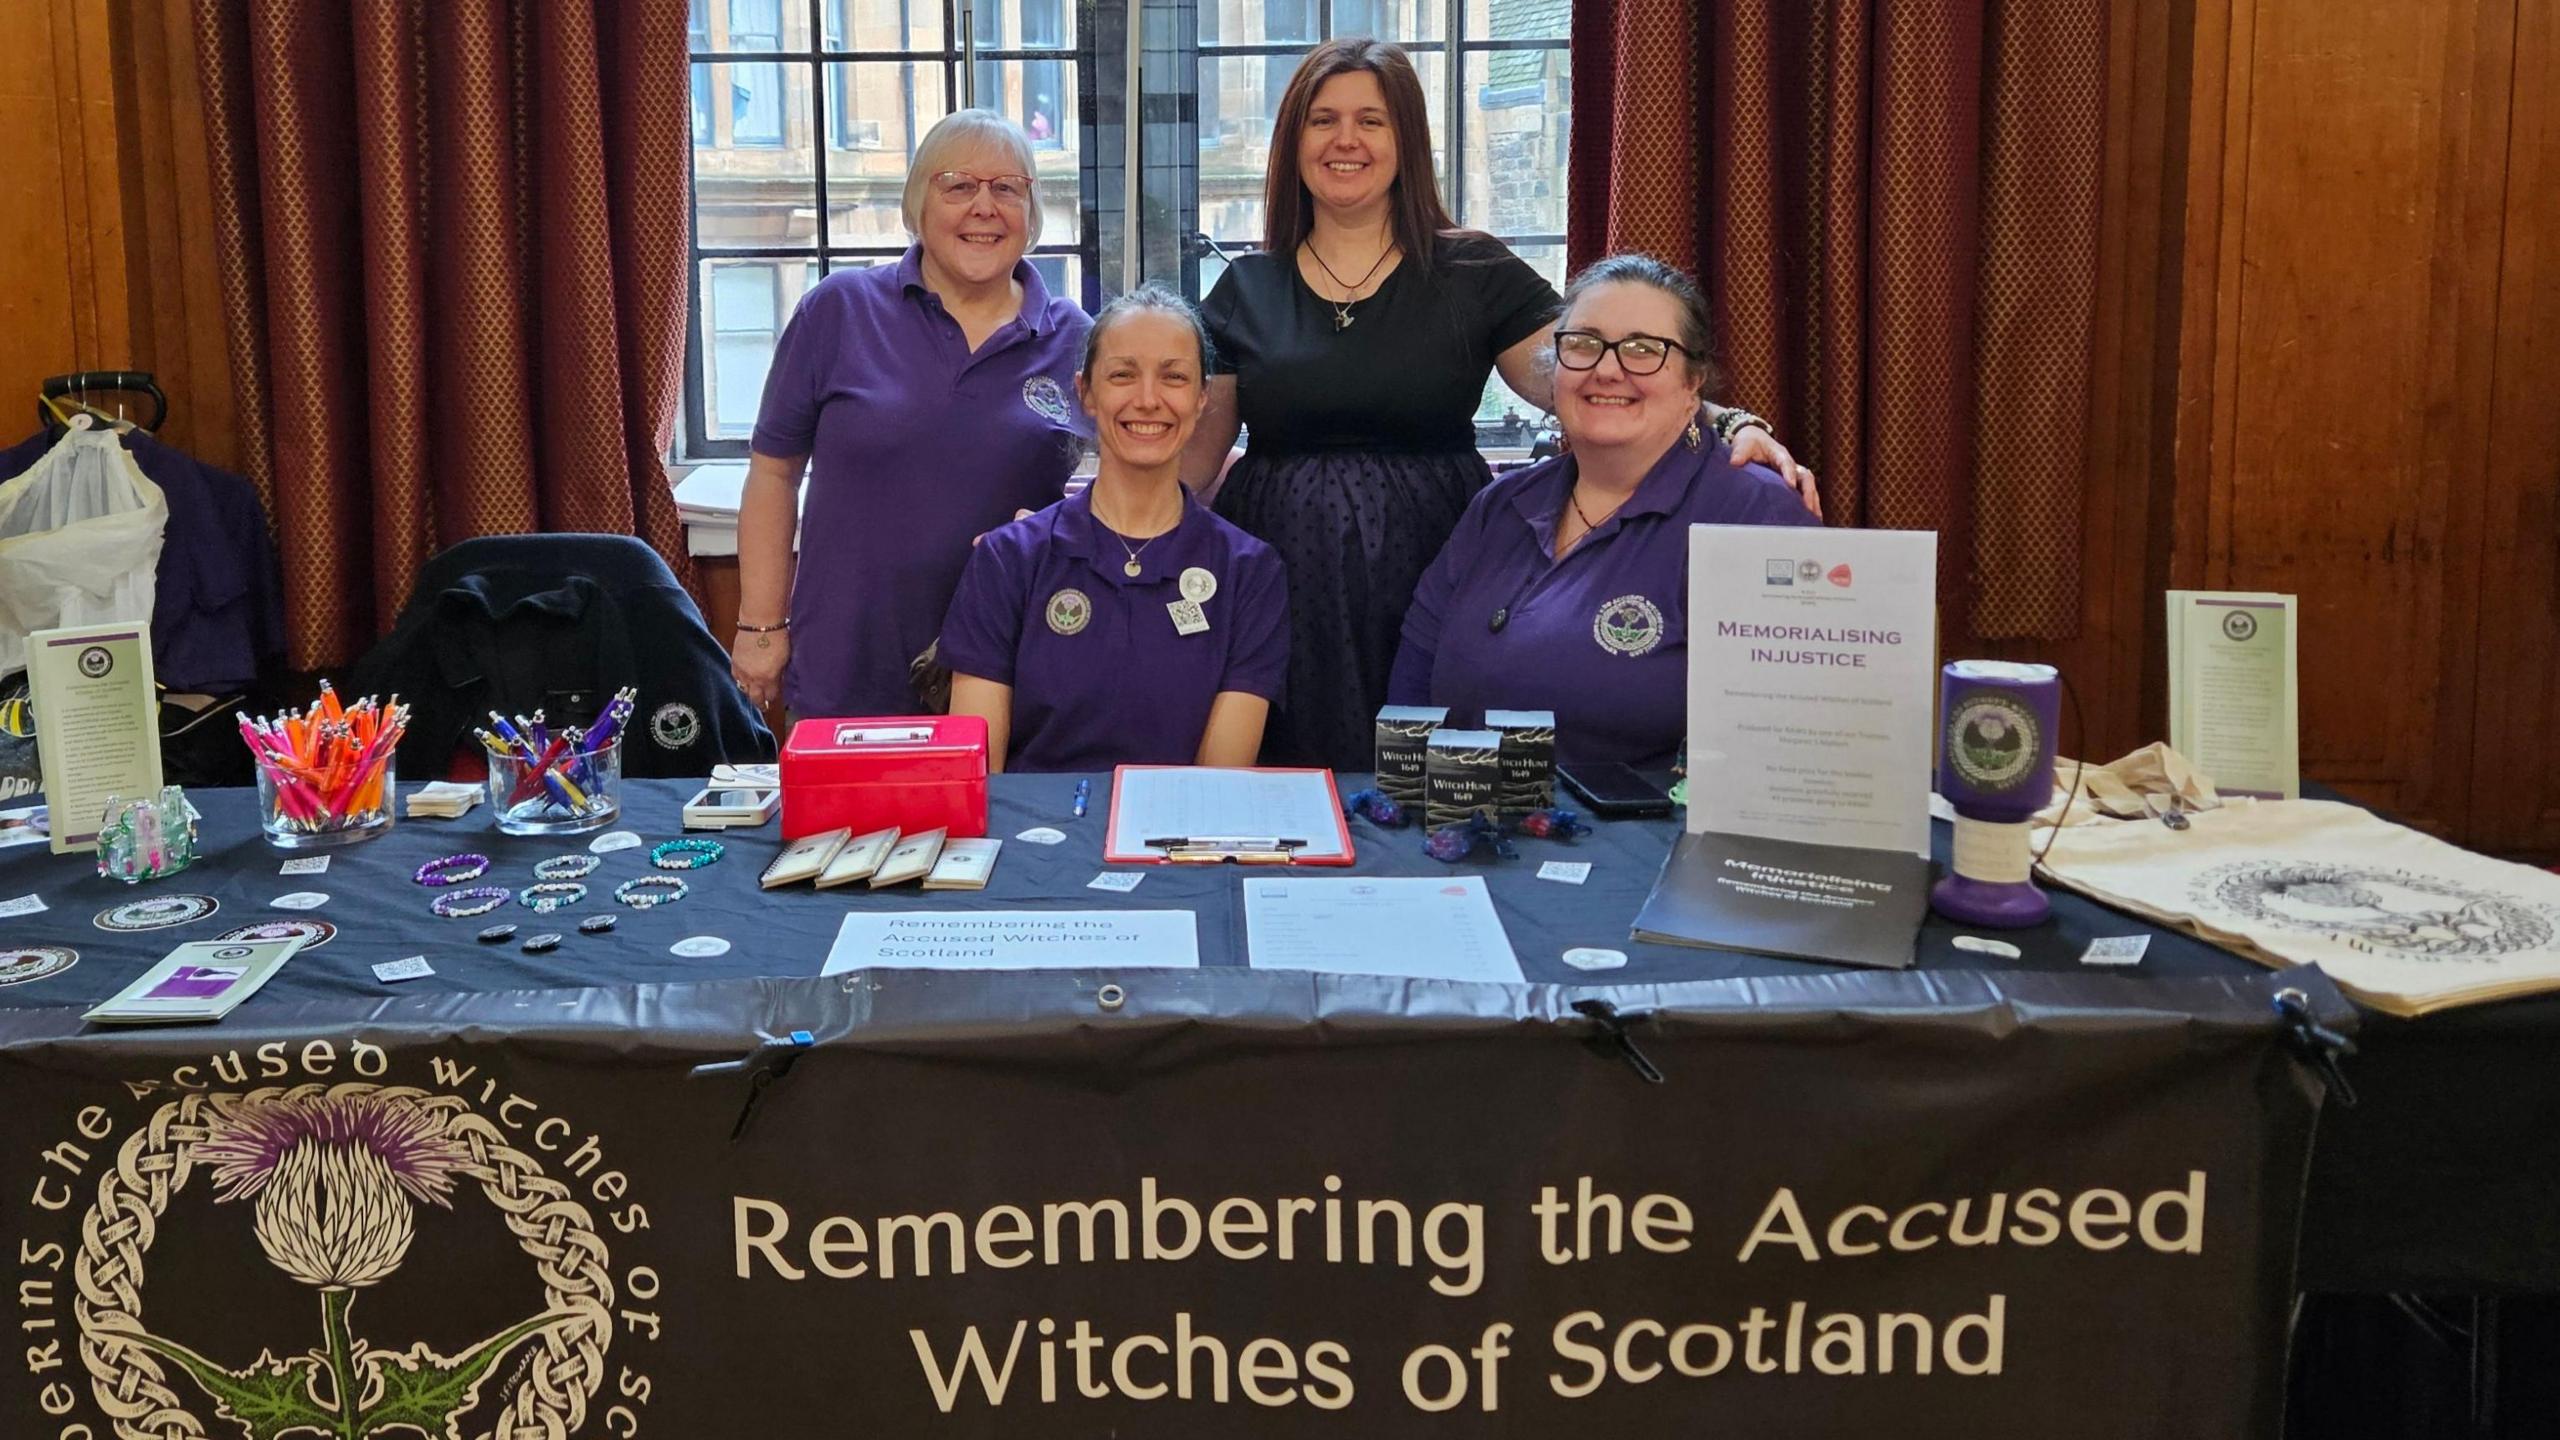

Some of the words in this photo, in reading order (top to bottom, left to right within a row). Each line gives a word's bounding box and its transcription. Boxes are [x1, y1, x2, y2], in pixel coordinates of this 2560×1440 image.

[1750, 648, 1866, 668] INJUSTICE
[1453, 791, 1473, 801] 1649
[889, 918, 1066, 930] Remembering
[1073, 919, 1114, 929] the
[882, 932, 995, 943] Accused
[1003, 932, 1108, 943] Witches
[1115, 932, 1141, 942] of
[876, 947, 995, 958] Scotland
[733, 1174, 1484, 1297] Remembering
[1531, 1175, 1694, 1265] the
[1738, 1170, 2206, 1262] Accused
[909, 1312, 1354, 1413] Witches
[1401, 1322, 1514, 1412] of
[1549, 1294, 2006, 1398] Scotland
